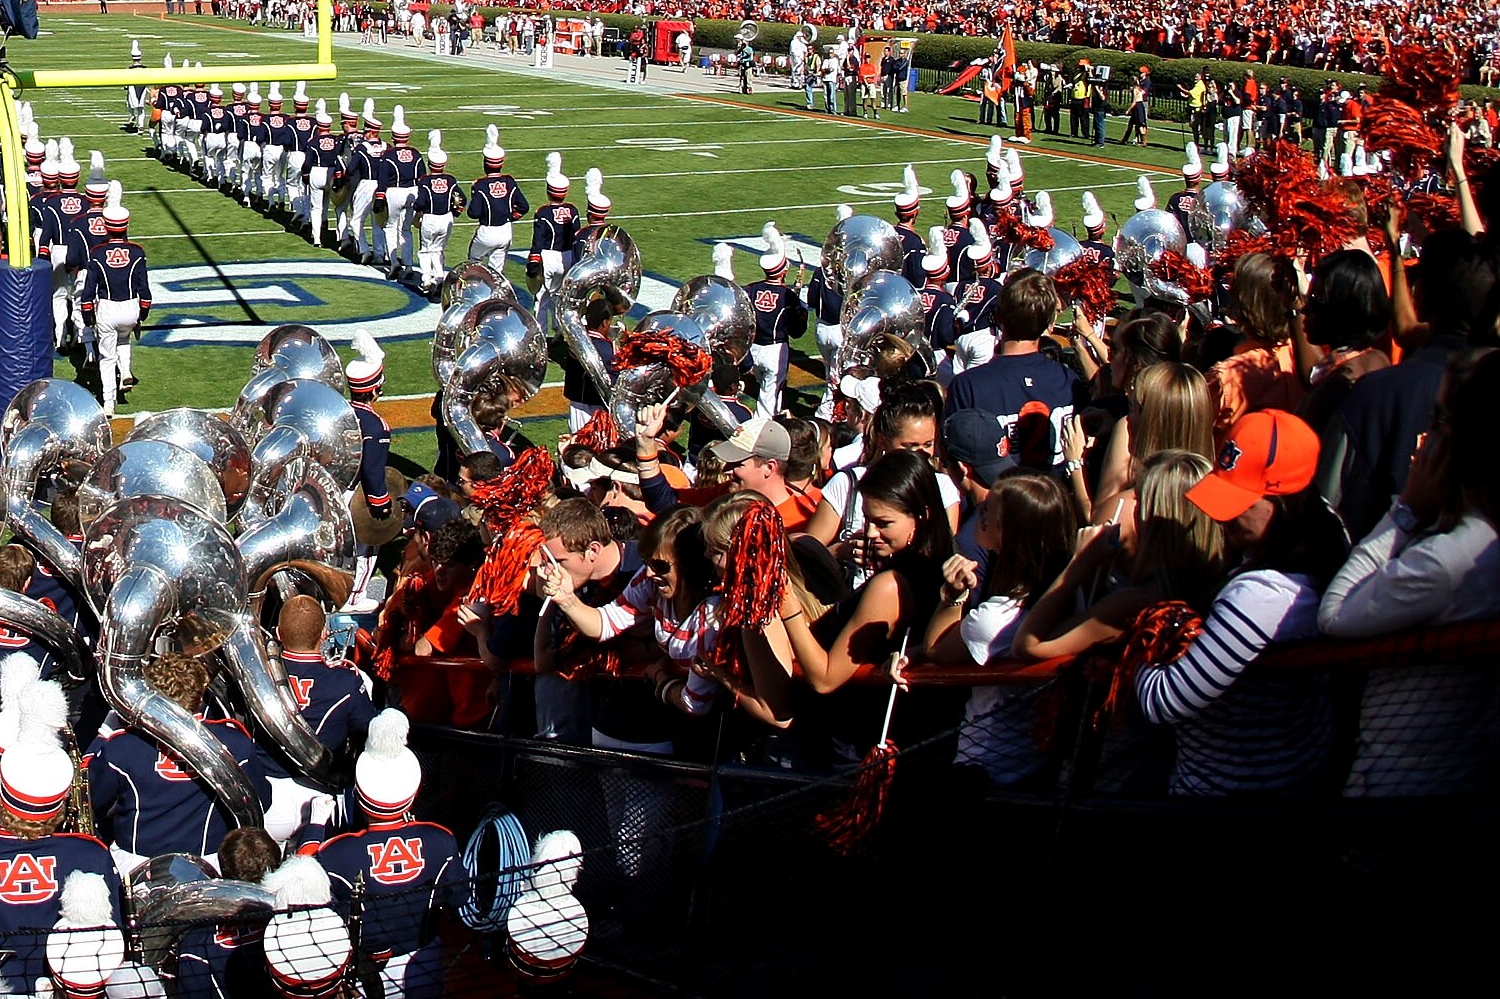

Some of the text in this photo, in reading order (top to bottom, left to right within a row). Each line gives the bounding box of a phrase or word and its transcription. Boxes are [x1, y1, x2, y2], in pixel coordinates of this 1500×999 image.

[431, 178, 449, 194] AU
[489, 181, 508, 198] AU
[61, 197, 82, 215] AU
[552, 207, 573, 224] AU
[105, 248, 130, 268] AU
[755, 290, 780, 312] AU
[367, 836, 427, 885] AU
